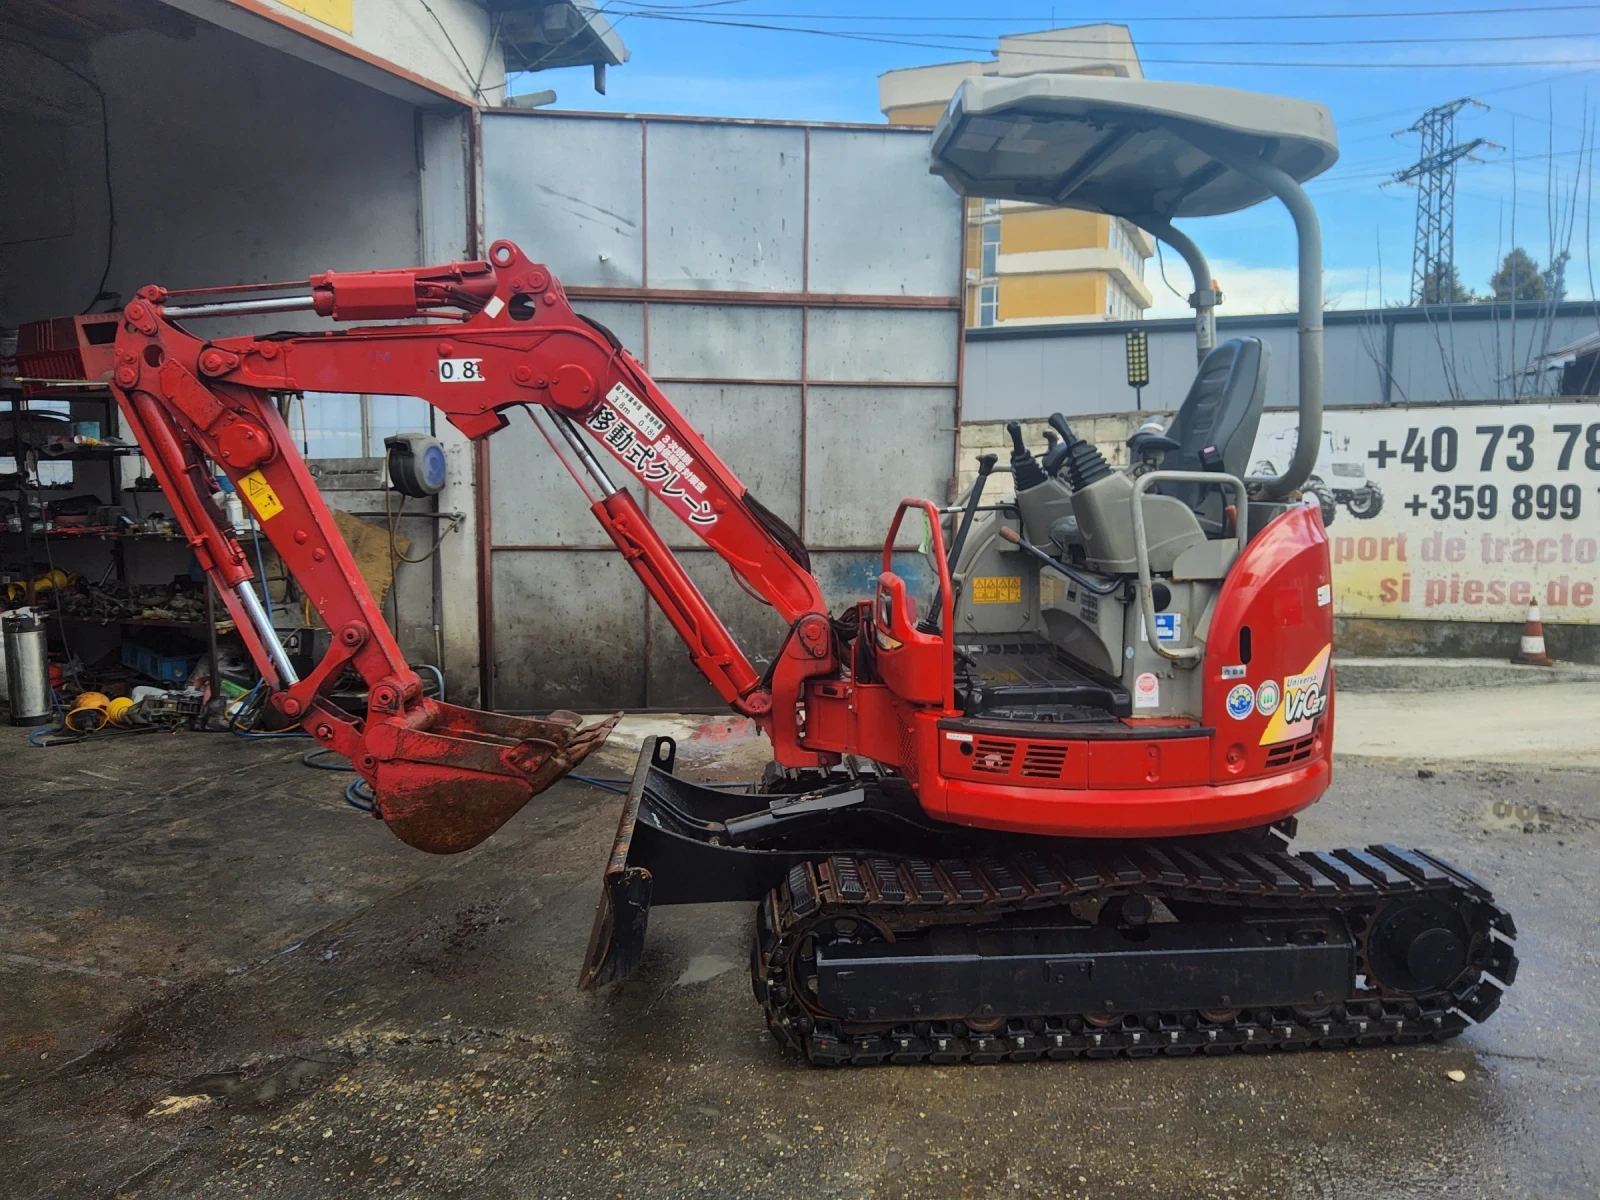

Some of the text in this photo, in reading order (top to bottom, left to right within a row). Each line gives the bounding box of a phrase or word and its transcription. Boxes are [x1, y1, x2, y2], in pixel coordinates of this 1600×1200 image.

[611, 396, 631, 415] 3.8m
[587, 404, 717, 524] 移動式クレーン
[1368, 426, 1458, 473] +40
[1475, 424, 1535, 472] 73
[1405, 483, 1582, 521] +359 899
[1421, 530, 1466, 563] de
[1380, 572, 1594, 608] si piese de
